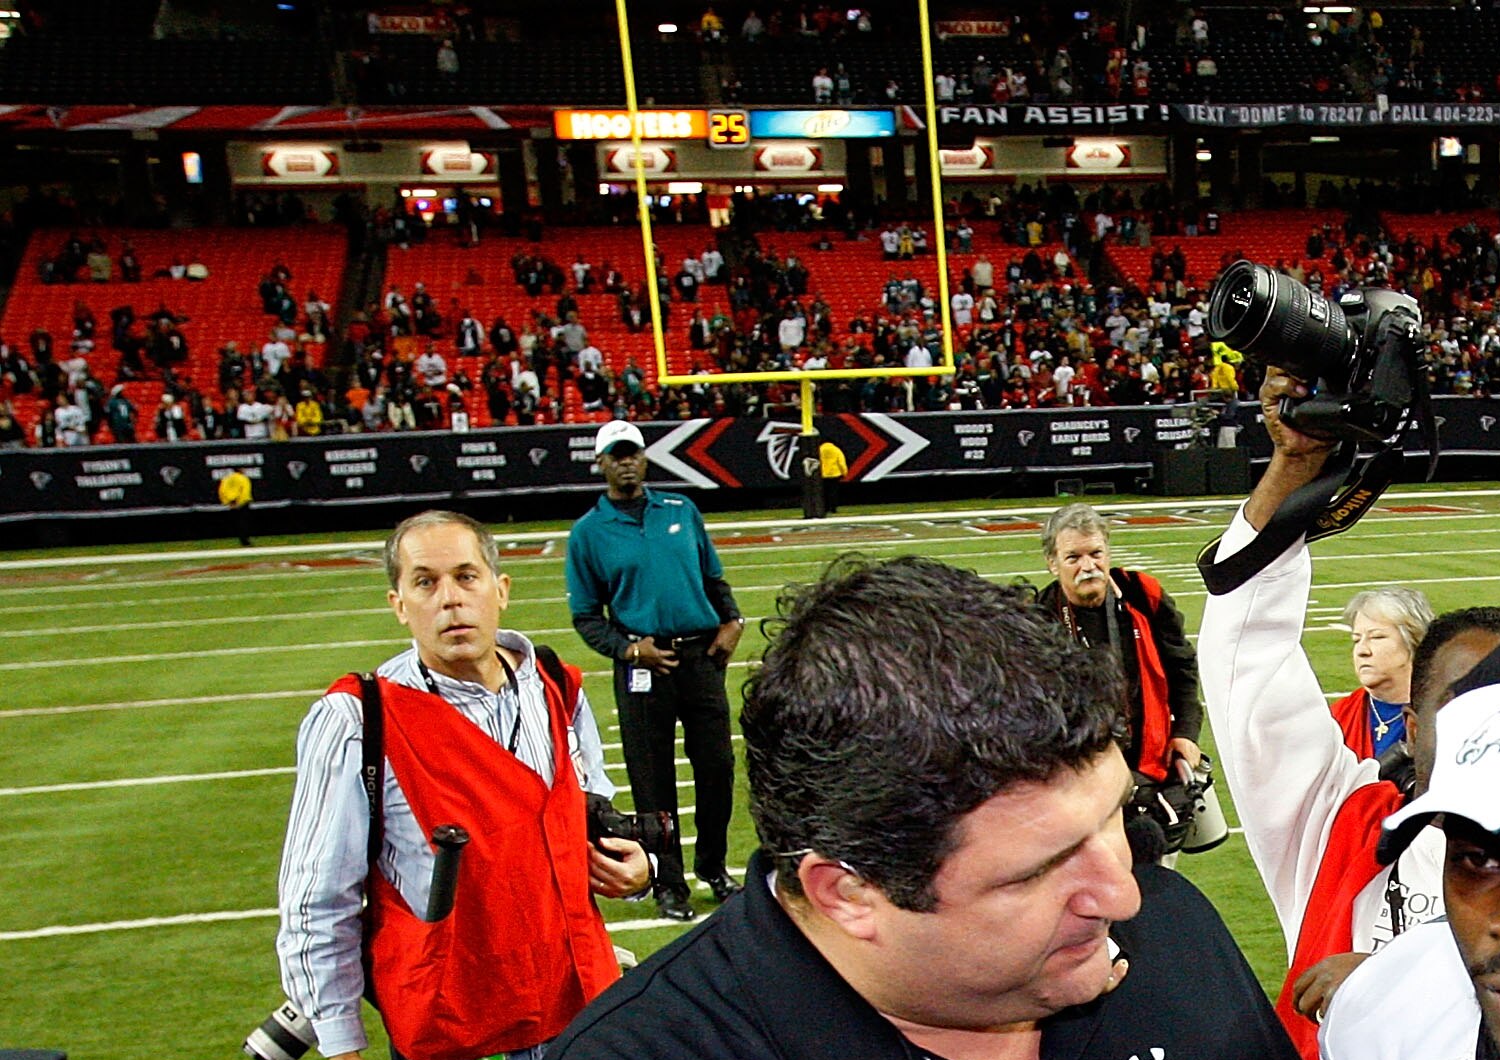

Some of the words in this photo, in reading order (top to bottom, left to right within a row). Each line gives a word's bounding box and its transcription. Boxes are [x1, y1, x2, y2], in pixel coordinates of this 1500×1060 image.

[571, 112, 693, 139] HOOTERS
[941, 106, 1009, 125] FAN
[1187, 105, 1225, 122] TEXT
[1300, 105, 1314, 121] to
[1320, 106, 1364, 122] 78247
[1391, 104, 1429, 122] CALL
[710, 114, 747, 143] 25
[1051, 433, 1080, 445] EARLY
[1336, 489, 1372, 521] Nikon
